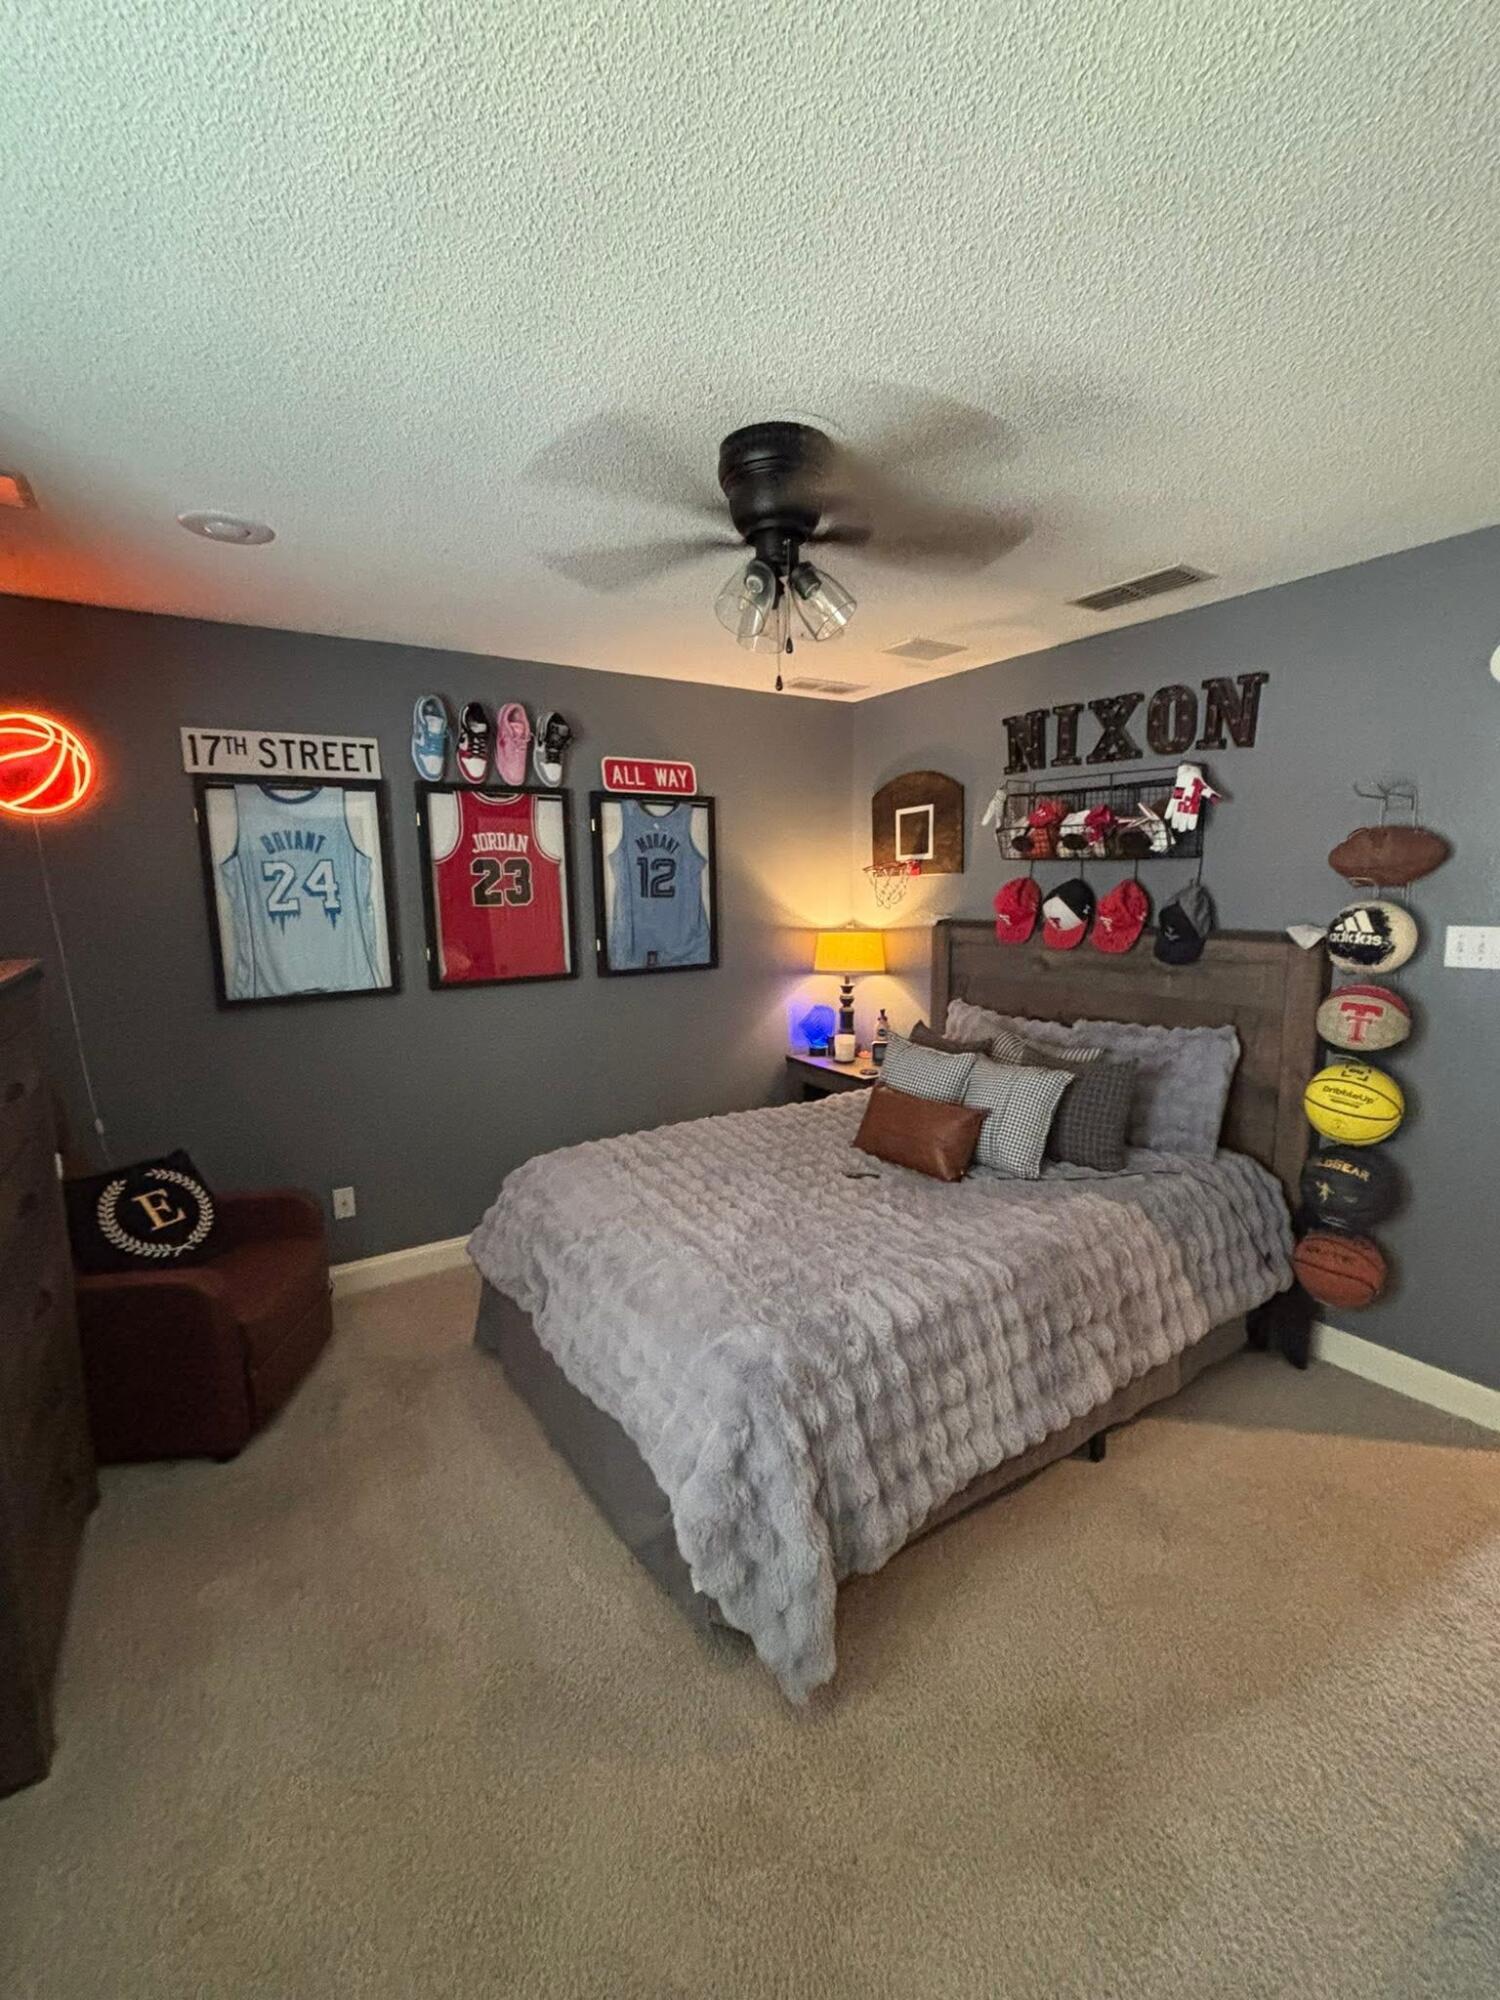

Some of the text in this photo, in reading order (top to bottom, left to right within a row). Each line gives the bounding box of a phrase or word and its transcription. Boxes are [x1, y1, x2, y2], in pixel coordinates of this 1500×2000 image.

[1002, 672, 1269, 775] NIXON
[187, 734, 374, 772] 17TH STREET
[612, 765, 687, 788] ALL WAY
[260, 829, 326, 854] BRYANT
[472, 832, 528, 853] JORDAN
[261, 859, 341, 922] 24
[470, 857, 534, 907] 23
[637, 857, 676, 898] 12
[1329, 930, 1383, 946] adidas
[132, 1188, 187, 1231] E
